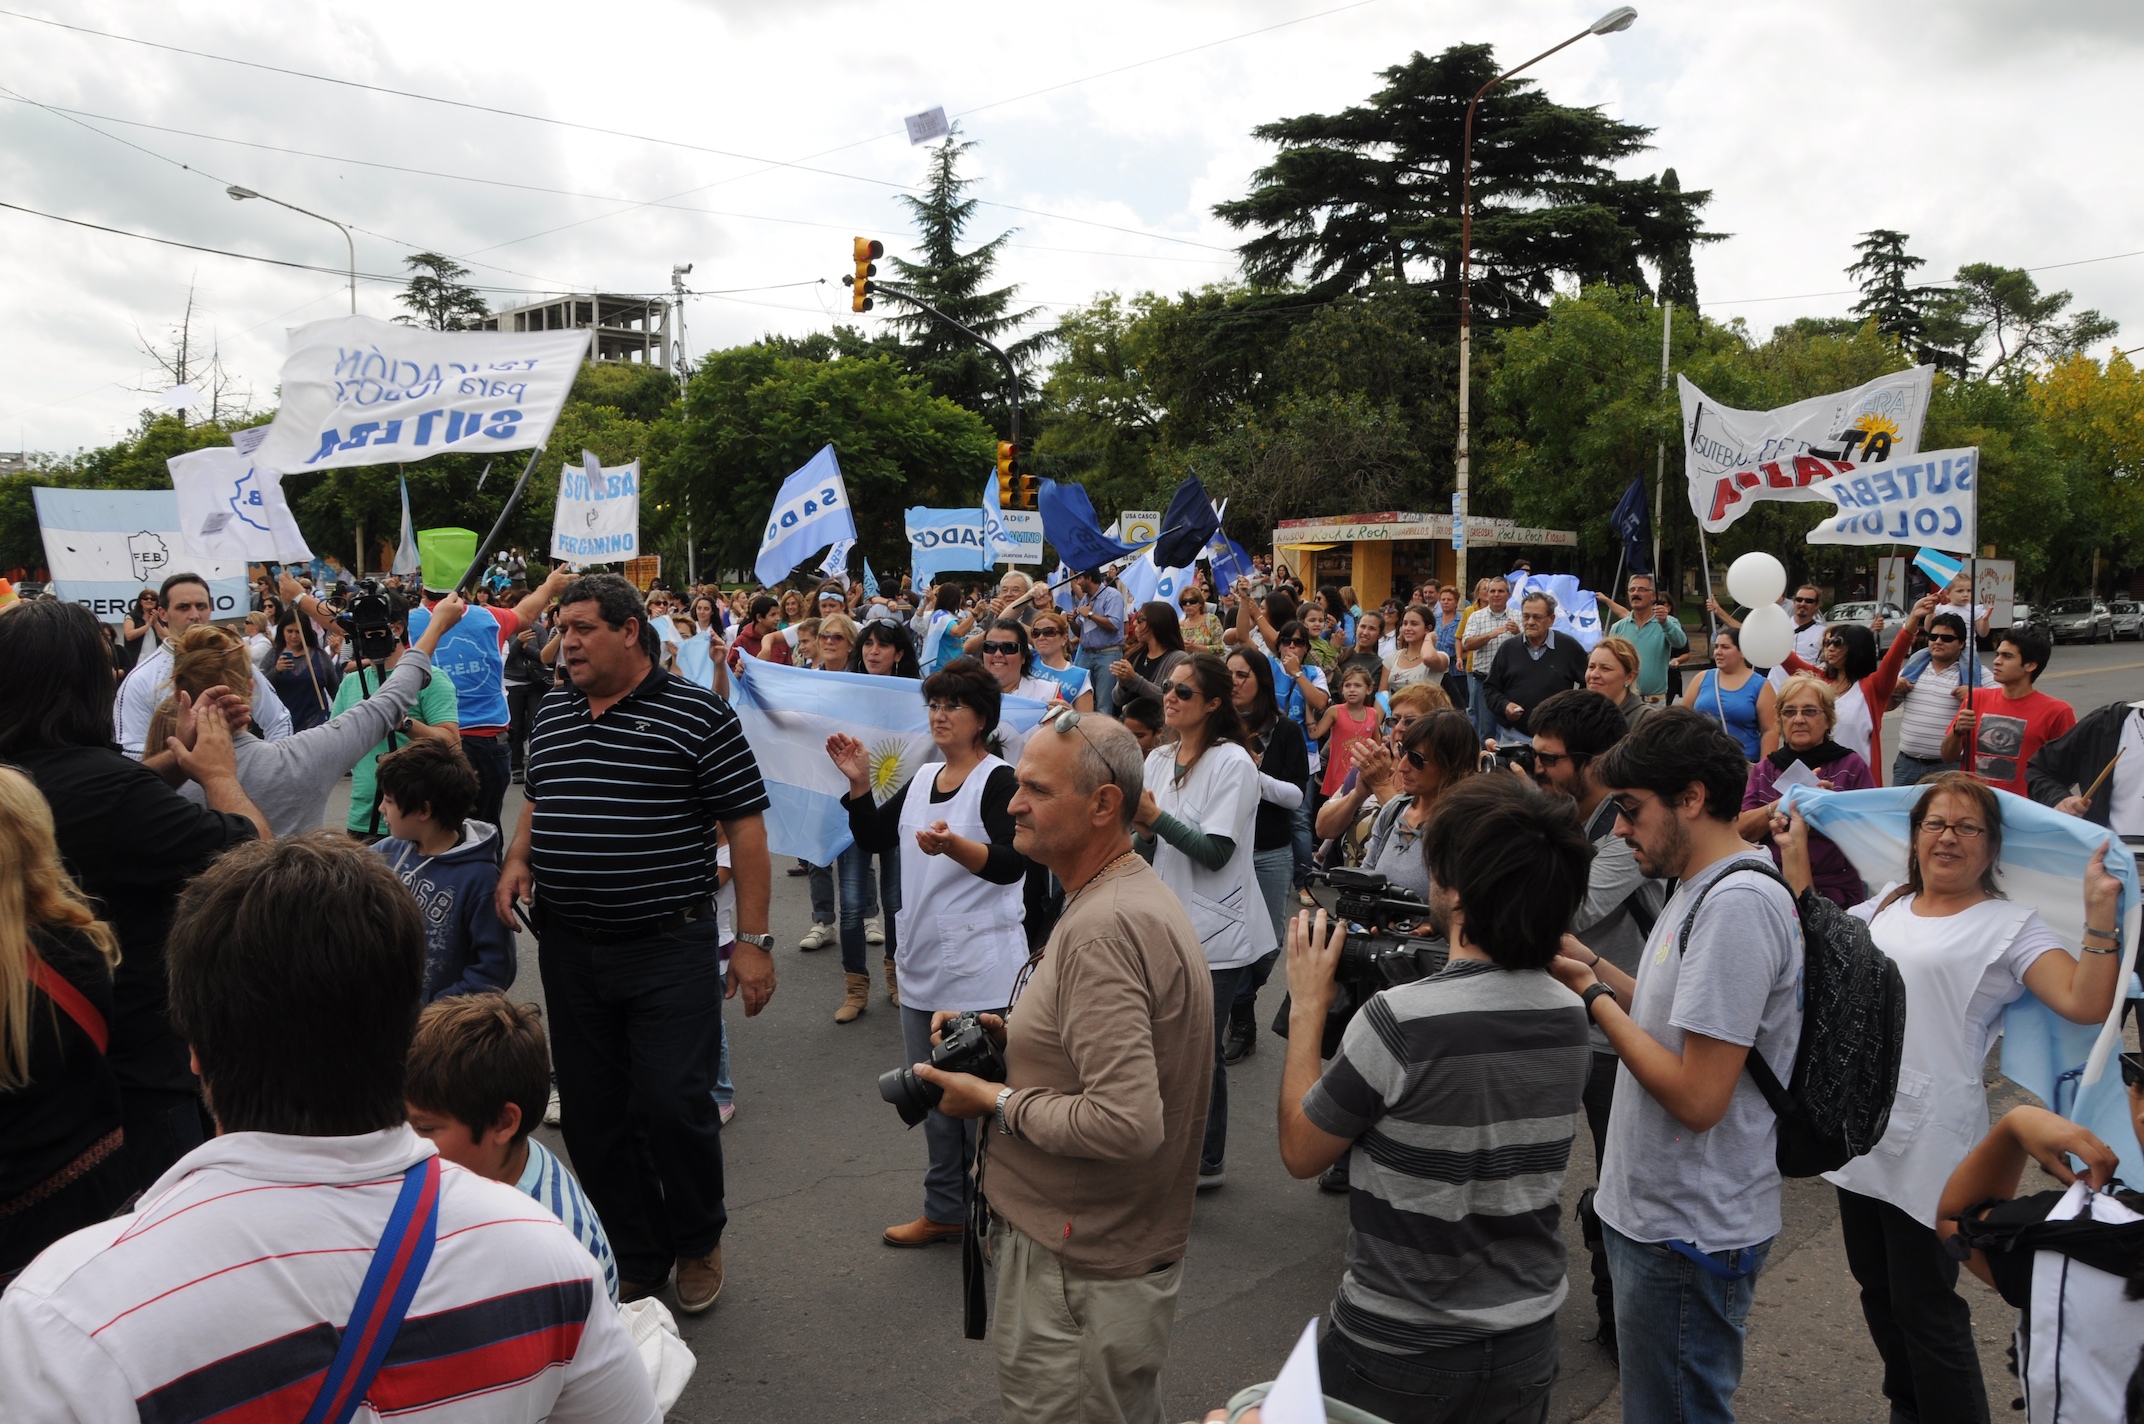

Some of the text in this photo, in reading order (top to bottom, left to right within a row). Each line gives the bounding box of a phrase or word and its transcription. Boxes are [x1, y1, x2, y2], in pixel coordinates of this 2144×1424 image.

[1009, 531, 1041, 544] AMINO
[1311, 525, 1388, 541] Rock & Roch
[558, 533, 634, 555] PERGAMINO
[133, 552, 165, 562] F.E.B.
